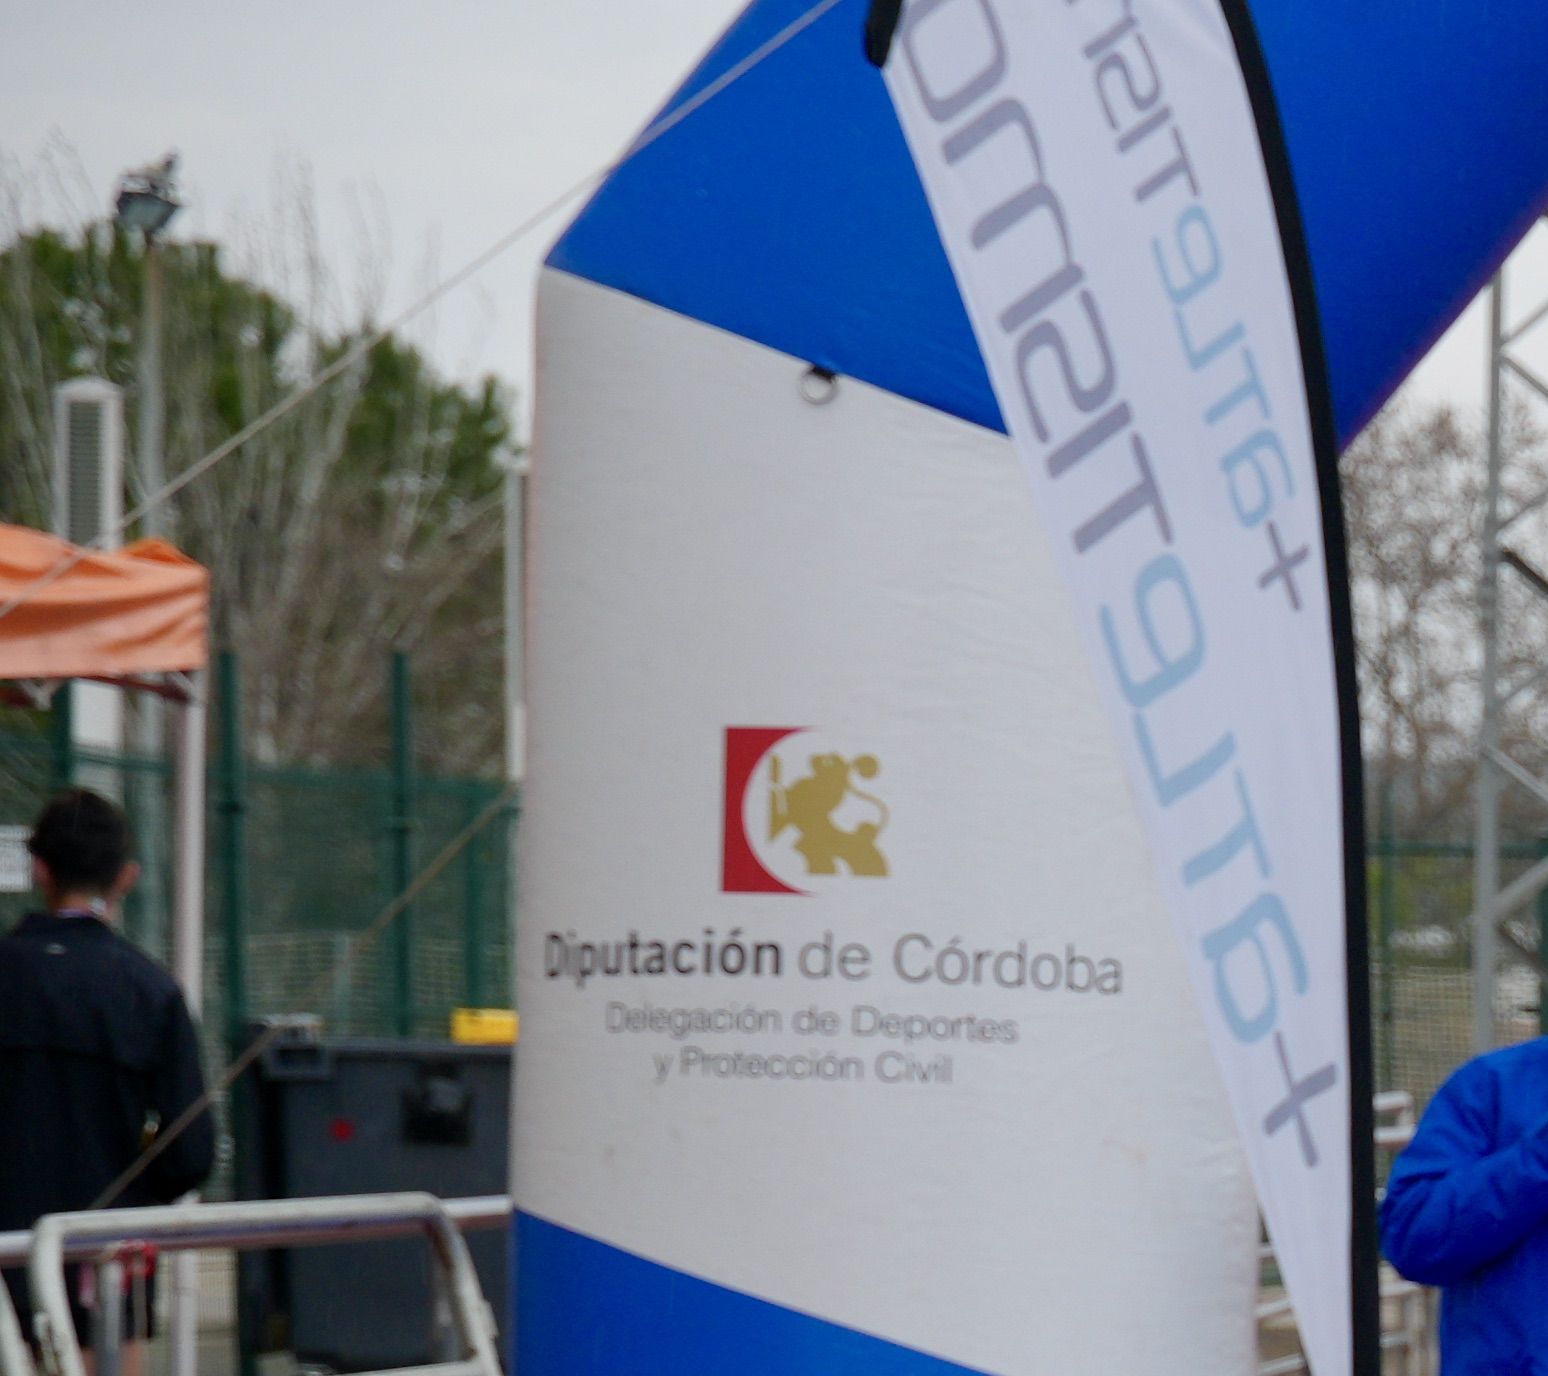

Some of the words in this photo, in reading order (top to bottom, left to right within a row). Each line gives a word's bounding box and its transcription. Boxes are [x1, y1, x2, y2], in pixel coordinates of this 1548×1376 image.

[544, 926, 783, 991] Diputación
[797, 930, 872, 982] de
[893, 931, 1125, 997] Córdoba
[605, 1000, 783, 1041] Delegación
[791, 1005, 840, 1037] de
[850, 1005, 1021, 1045] Deportes
[653, 1051, 675, 1084] y
[679, 1044, 865, 1083] Protección
[874, 1050, 954, 1085] Civil
